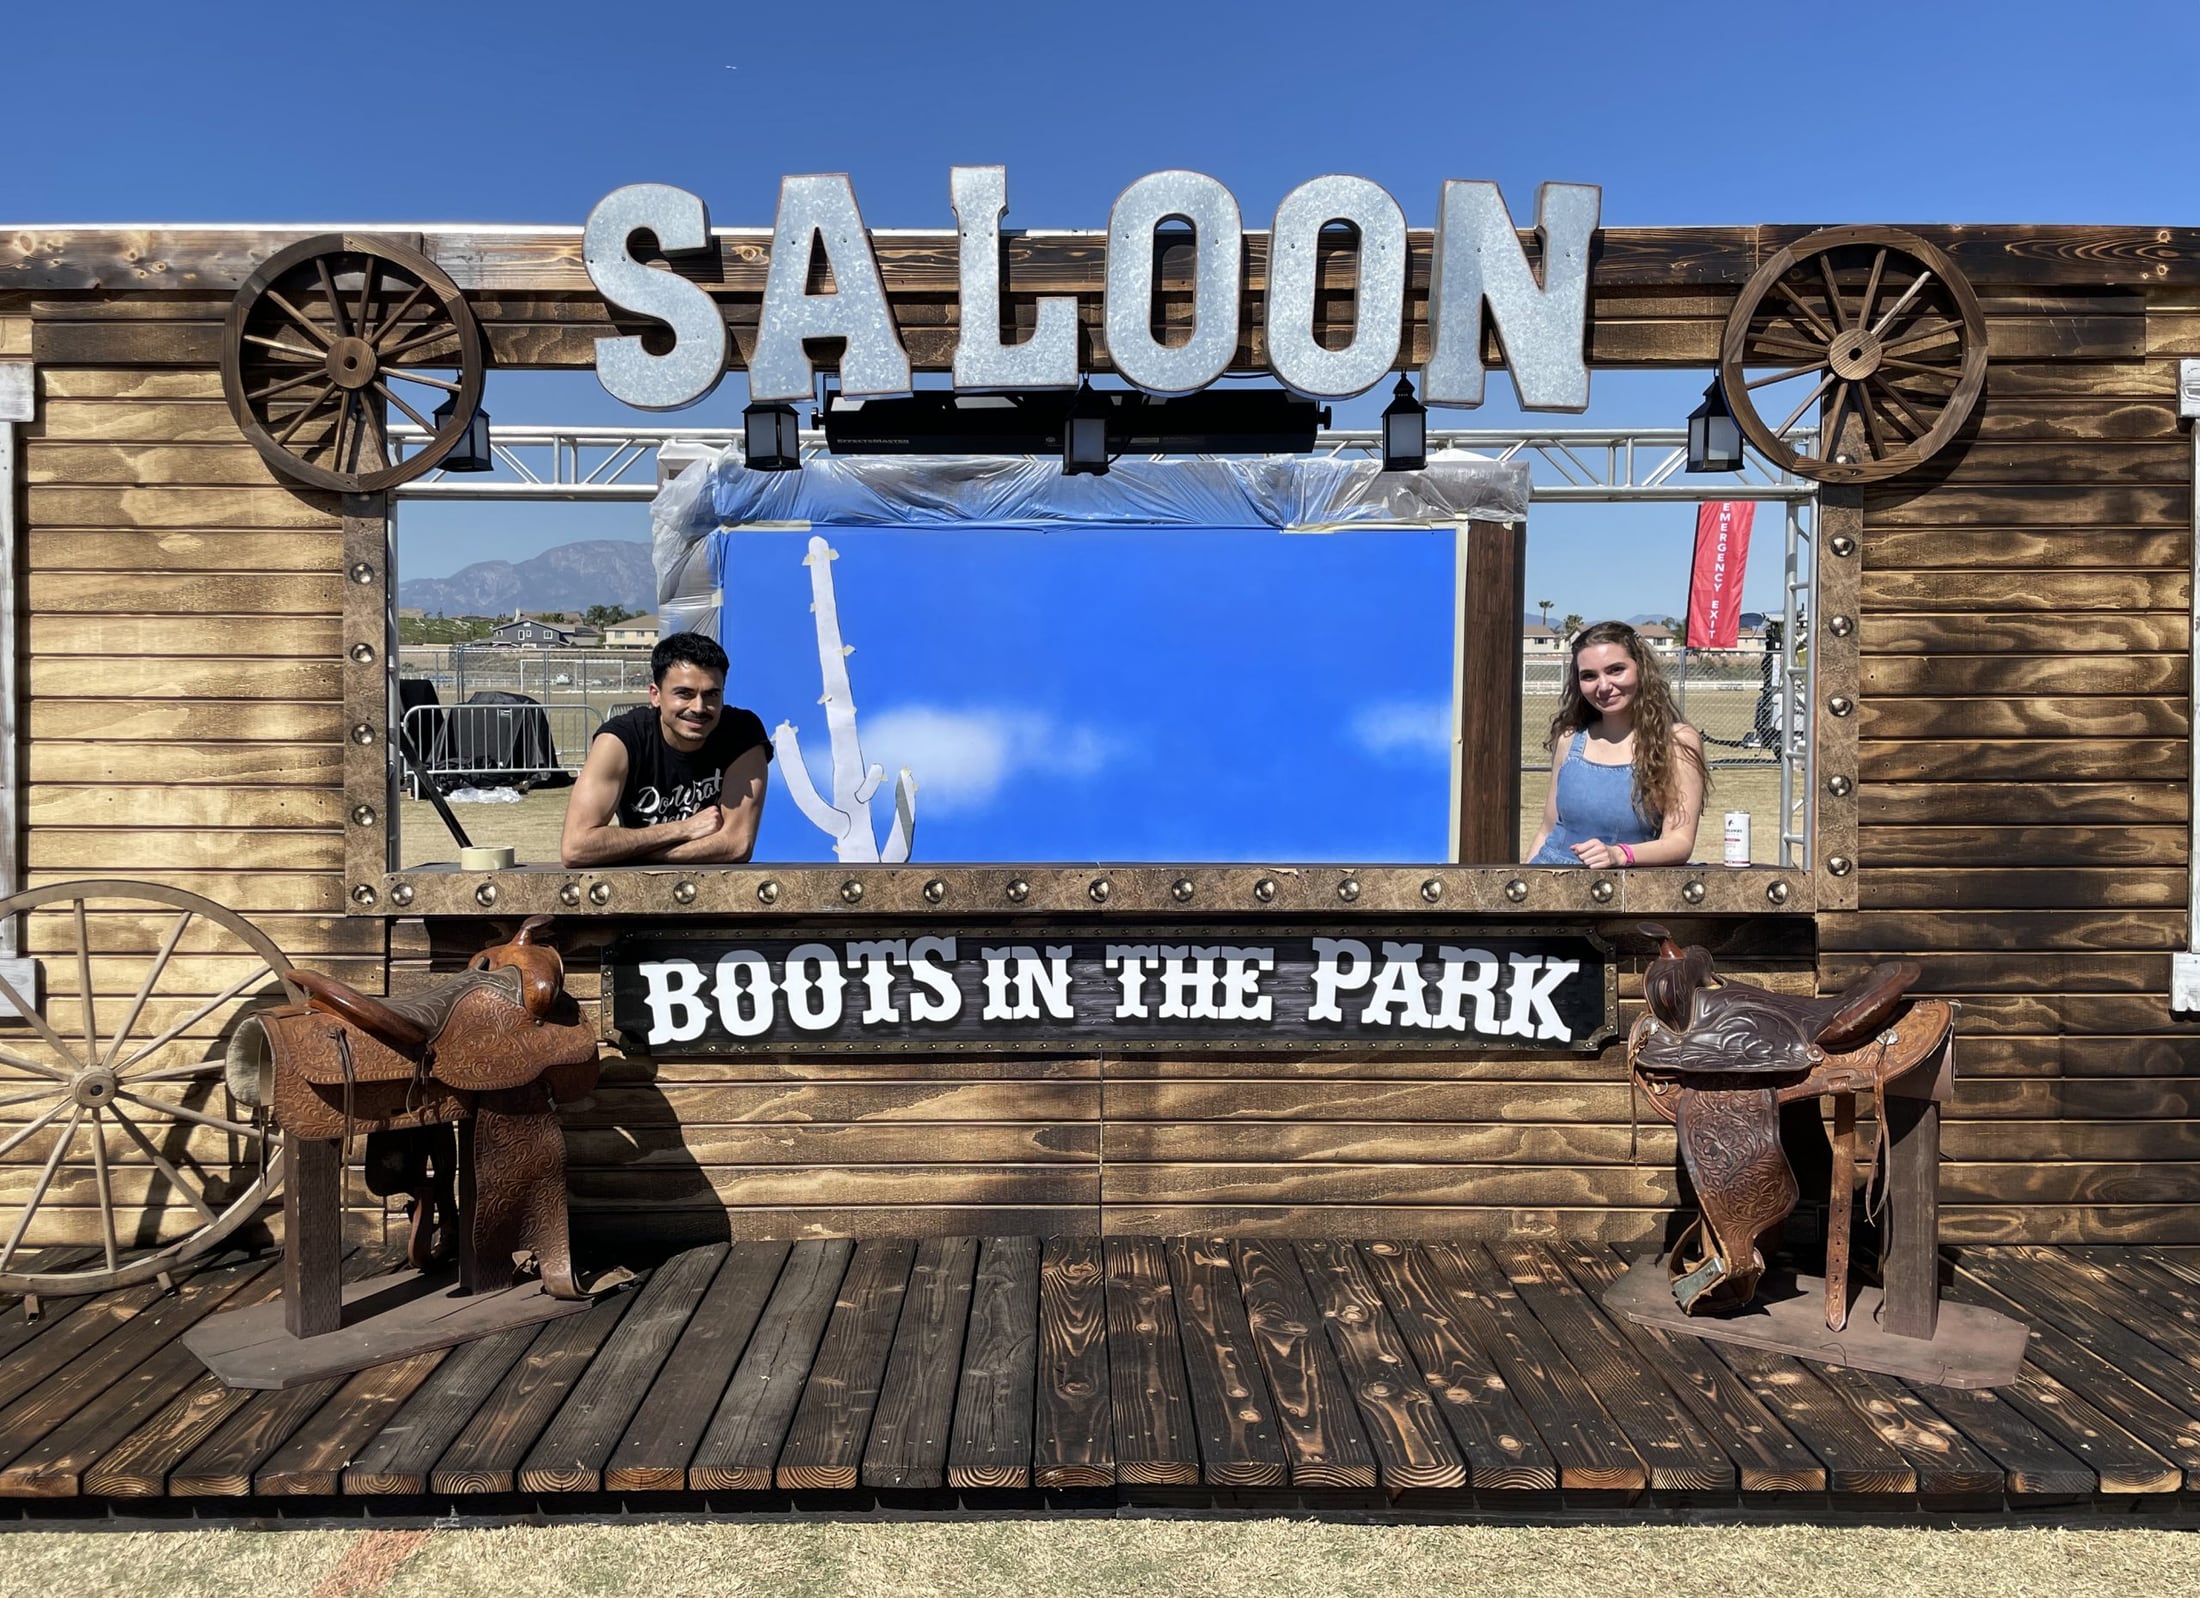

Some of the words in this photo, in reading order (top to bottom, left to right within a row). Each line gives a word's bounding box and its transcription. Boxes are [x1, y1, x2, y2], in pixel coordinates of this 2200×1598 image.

[583, 165, 1601, 412] SALOON
[1714, 502, 1731, 592] EMERGENCY
[1709, 600, 1719, 639] EXIT
[632, 786, 674, 814] Do
[638, 936, 962, 1046] BOOTS
[980, 944, 1074, 1021] IN
[1105, 944, 1275, 1022] THE
[1308, 937, 1580, 1043] PARK
